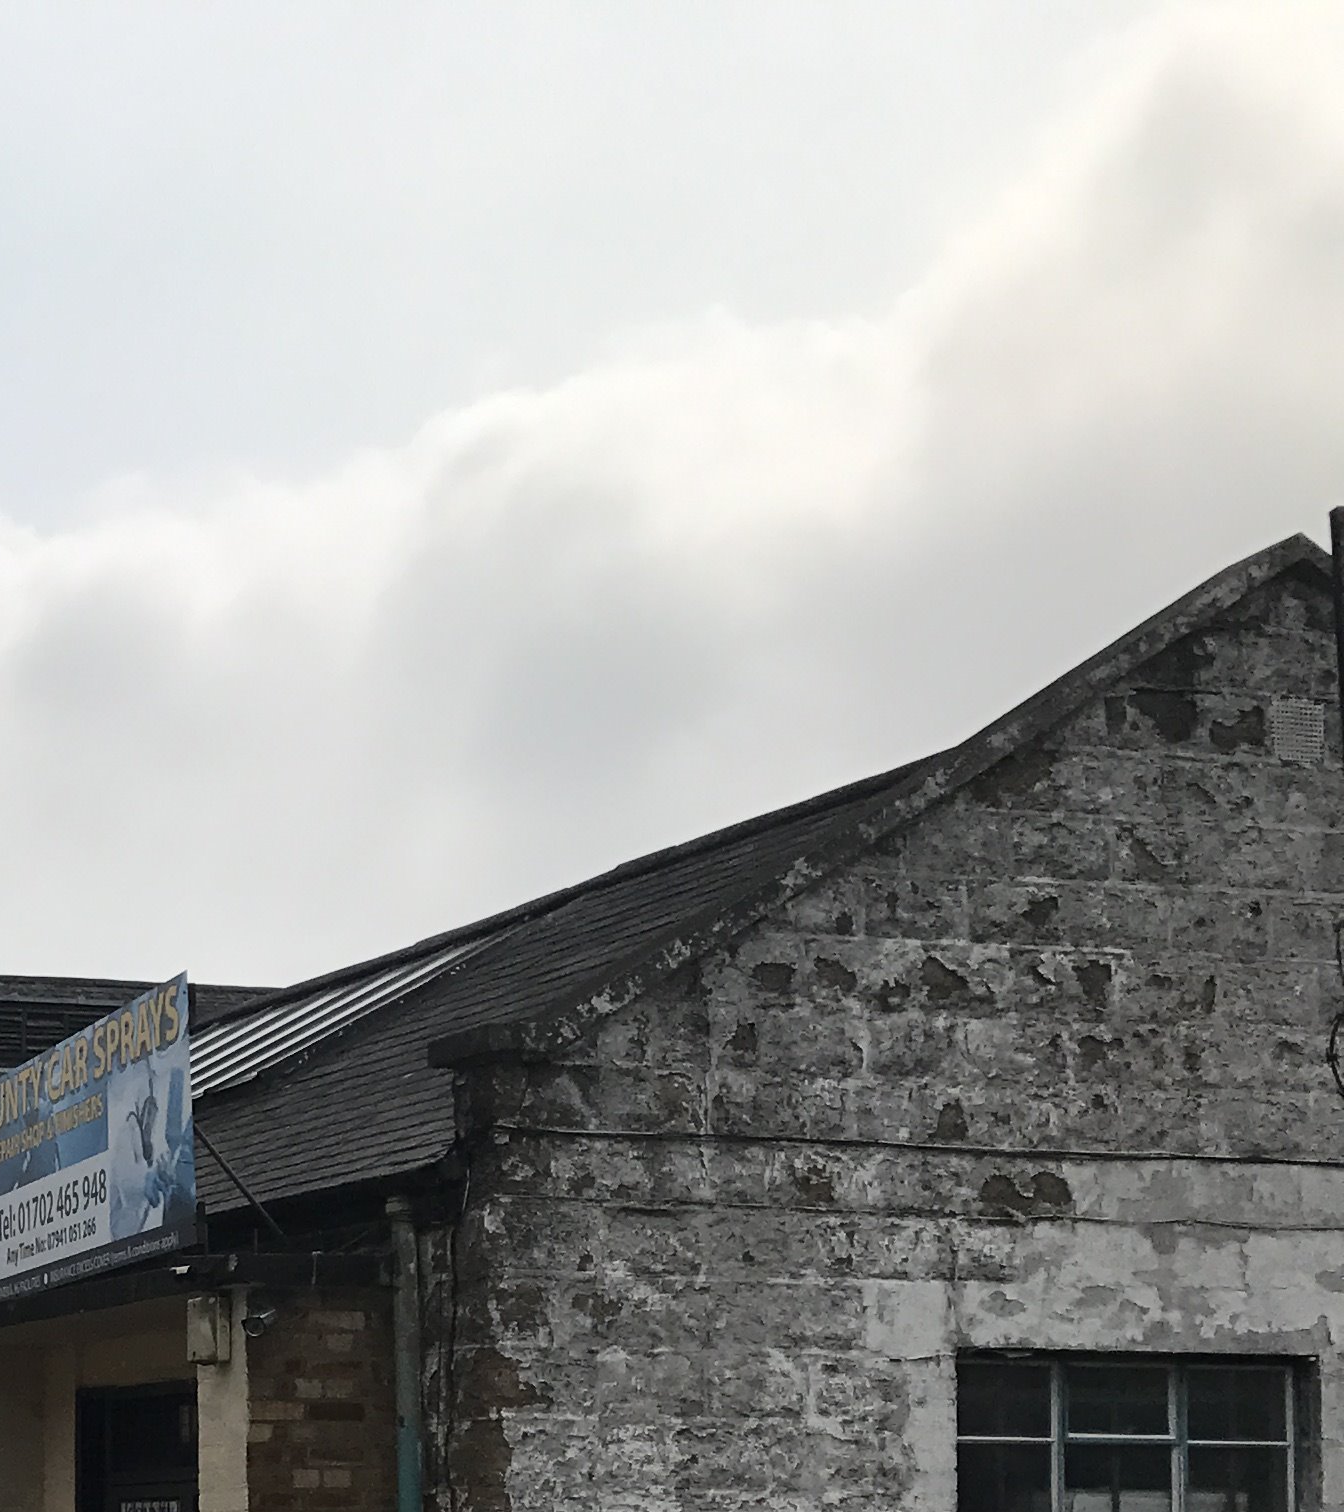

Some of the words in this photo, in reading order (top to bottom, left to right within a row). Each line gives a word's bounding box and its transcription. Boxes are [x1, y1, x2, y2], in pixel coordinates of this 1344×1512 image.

[47, 1036, 88, 1101] CAR
[93, 985, 179, 1080] SPRAYS
[22, 1121, 44, 1153] SHOP
[18, 1193, 53, 1234] 01702
[56, 1181, 79, 1219] 465
[82, 1168, 106, 1210] 948
[7, 1247, 19, 1267] Any
[19, 1241, 34, 1260] Time
